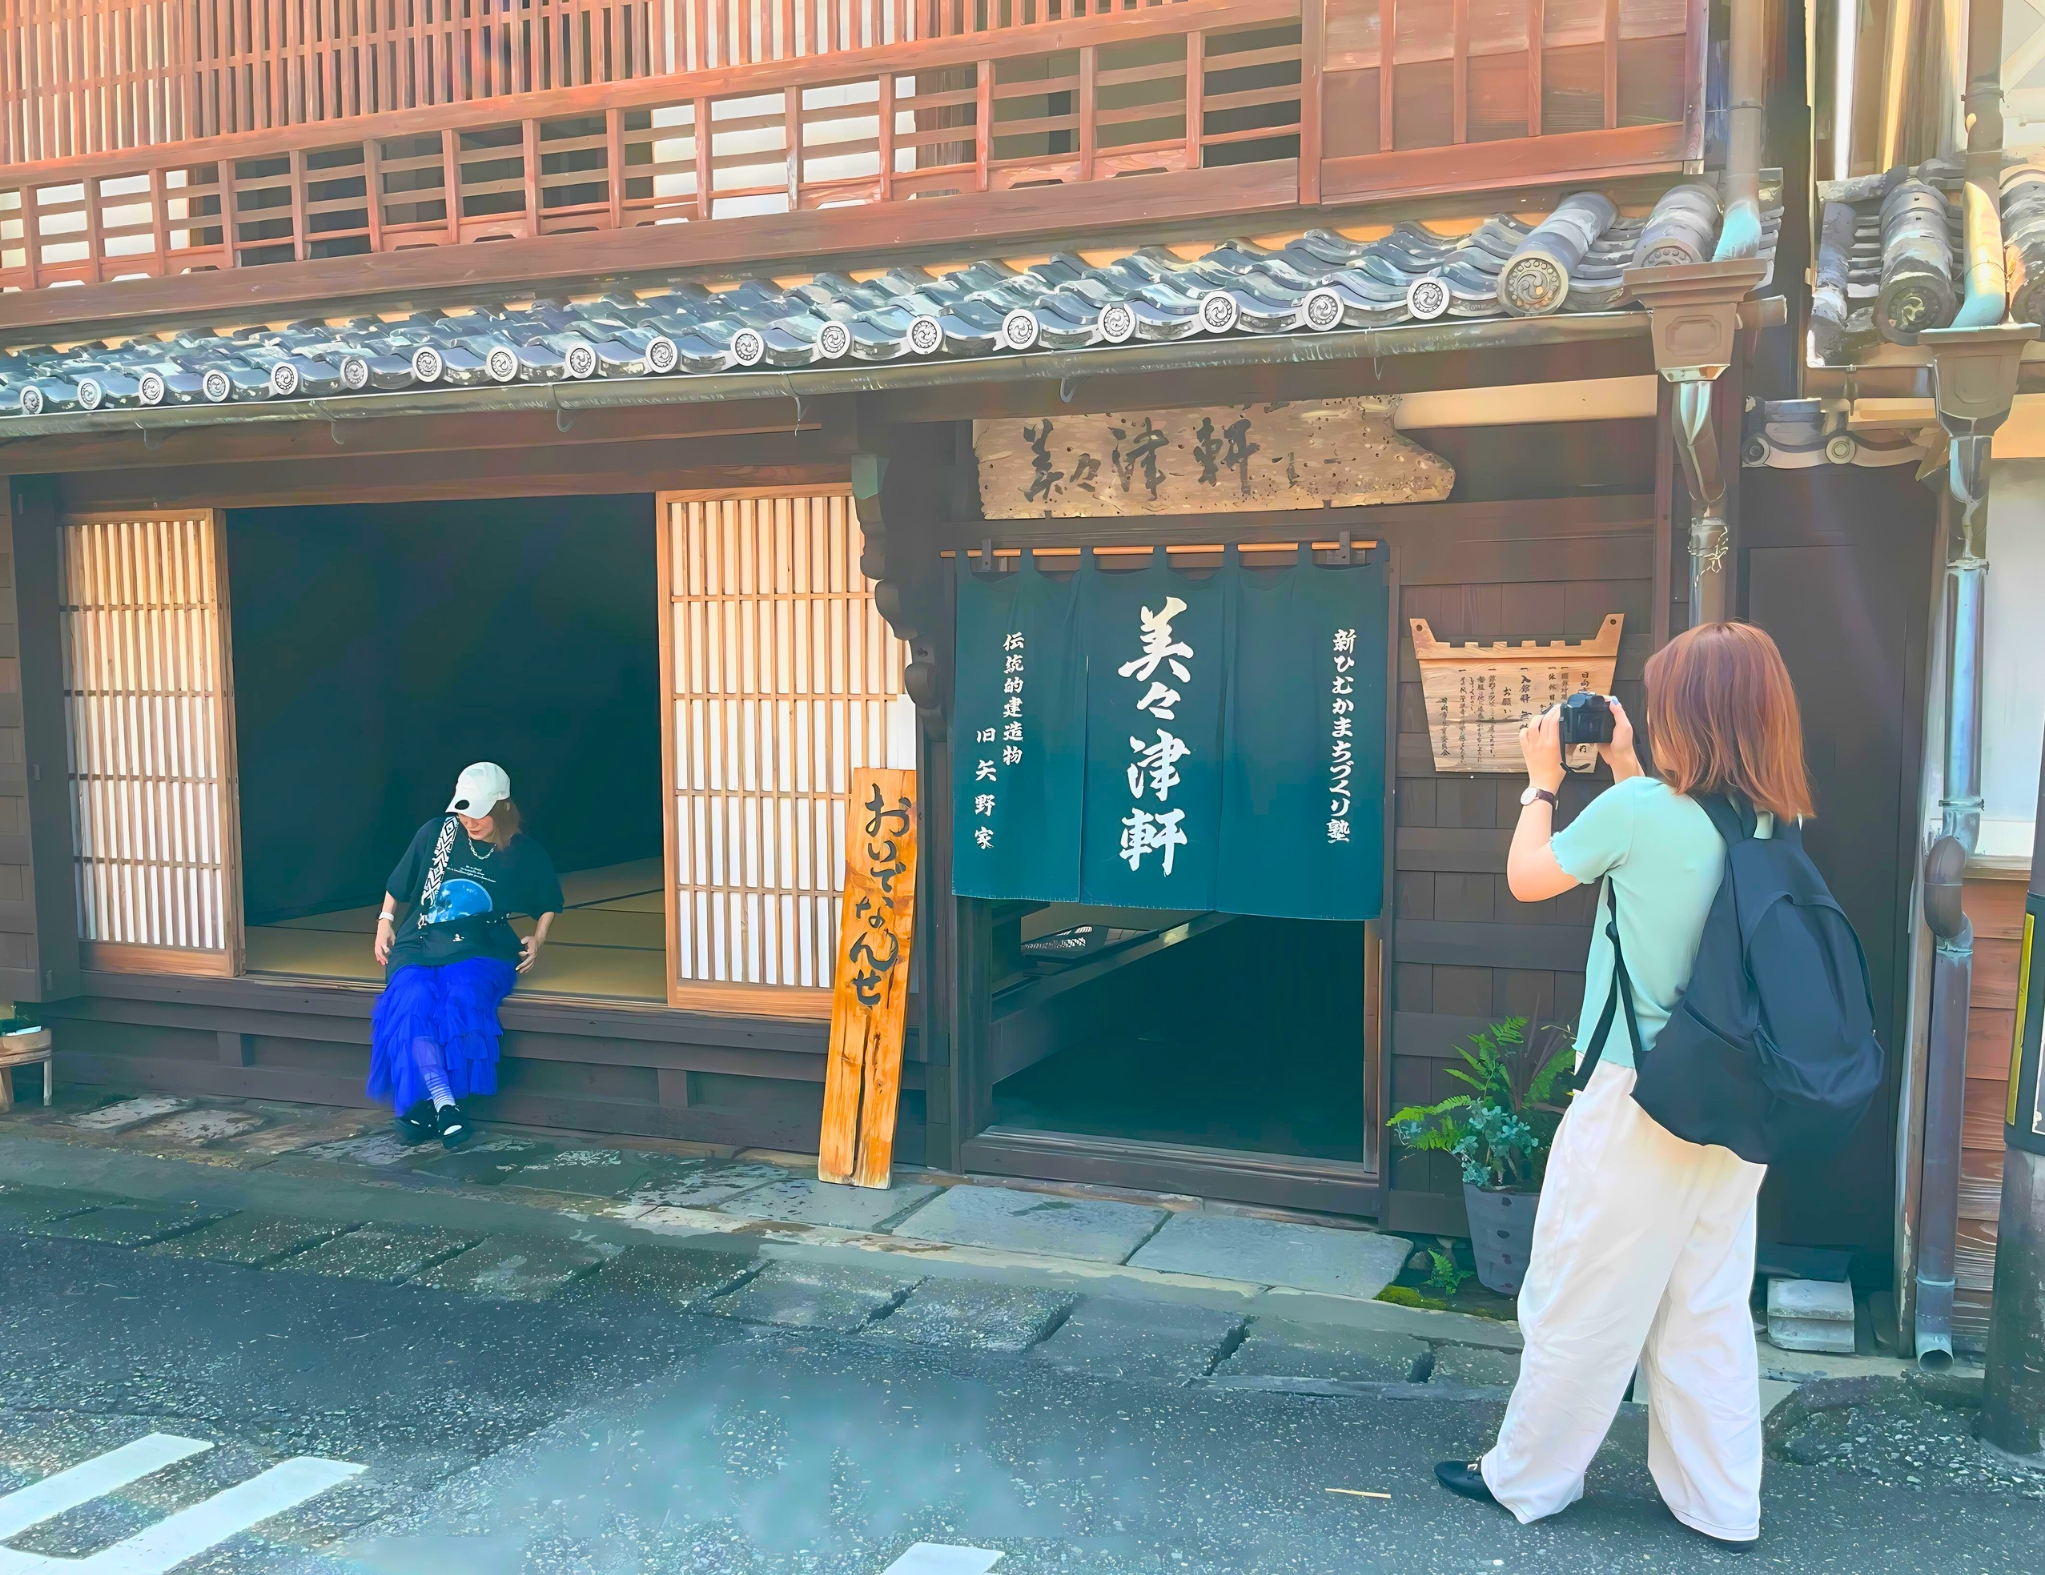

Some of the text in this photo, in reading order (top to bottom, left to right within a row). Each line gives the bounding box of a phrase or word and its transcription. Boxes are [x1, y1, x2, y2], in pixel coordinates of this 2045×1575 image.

[1023, 416, 1261, 502] 美々津軒
[1002, 631, 1025, 766] 伝統的建造物
[1117, 596, 1194, 877] 美々津軒
[1326, 628, 1358, 844] 新ひむかまちづくり塾
[974, 727, 998, 851] 旧矢野家
[849, 783, 912, 1009] おいでなんせ
